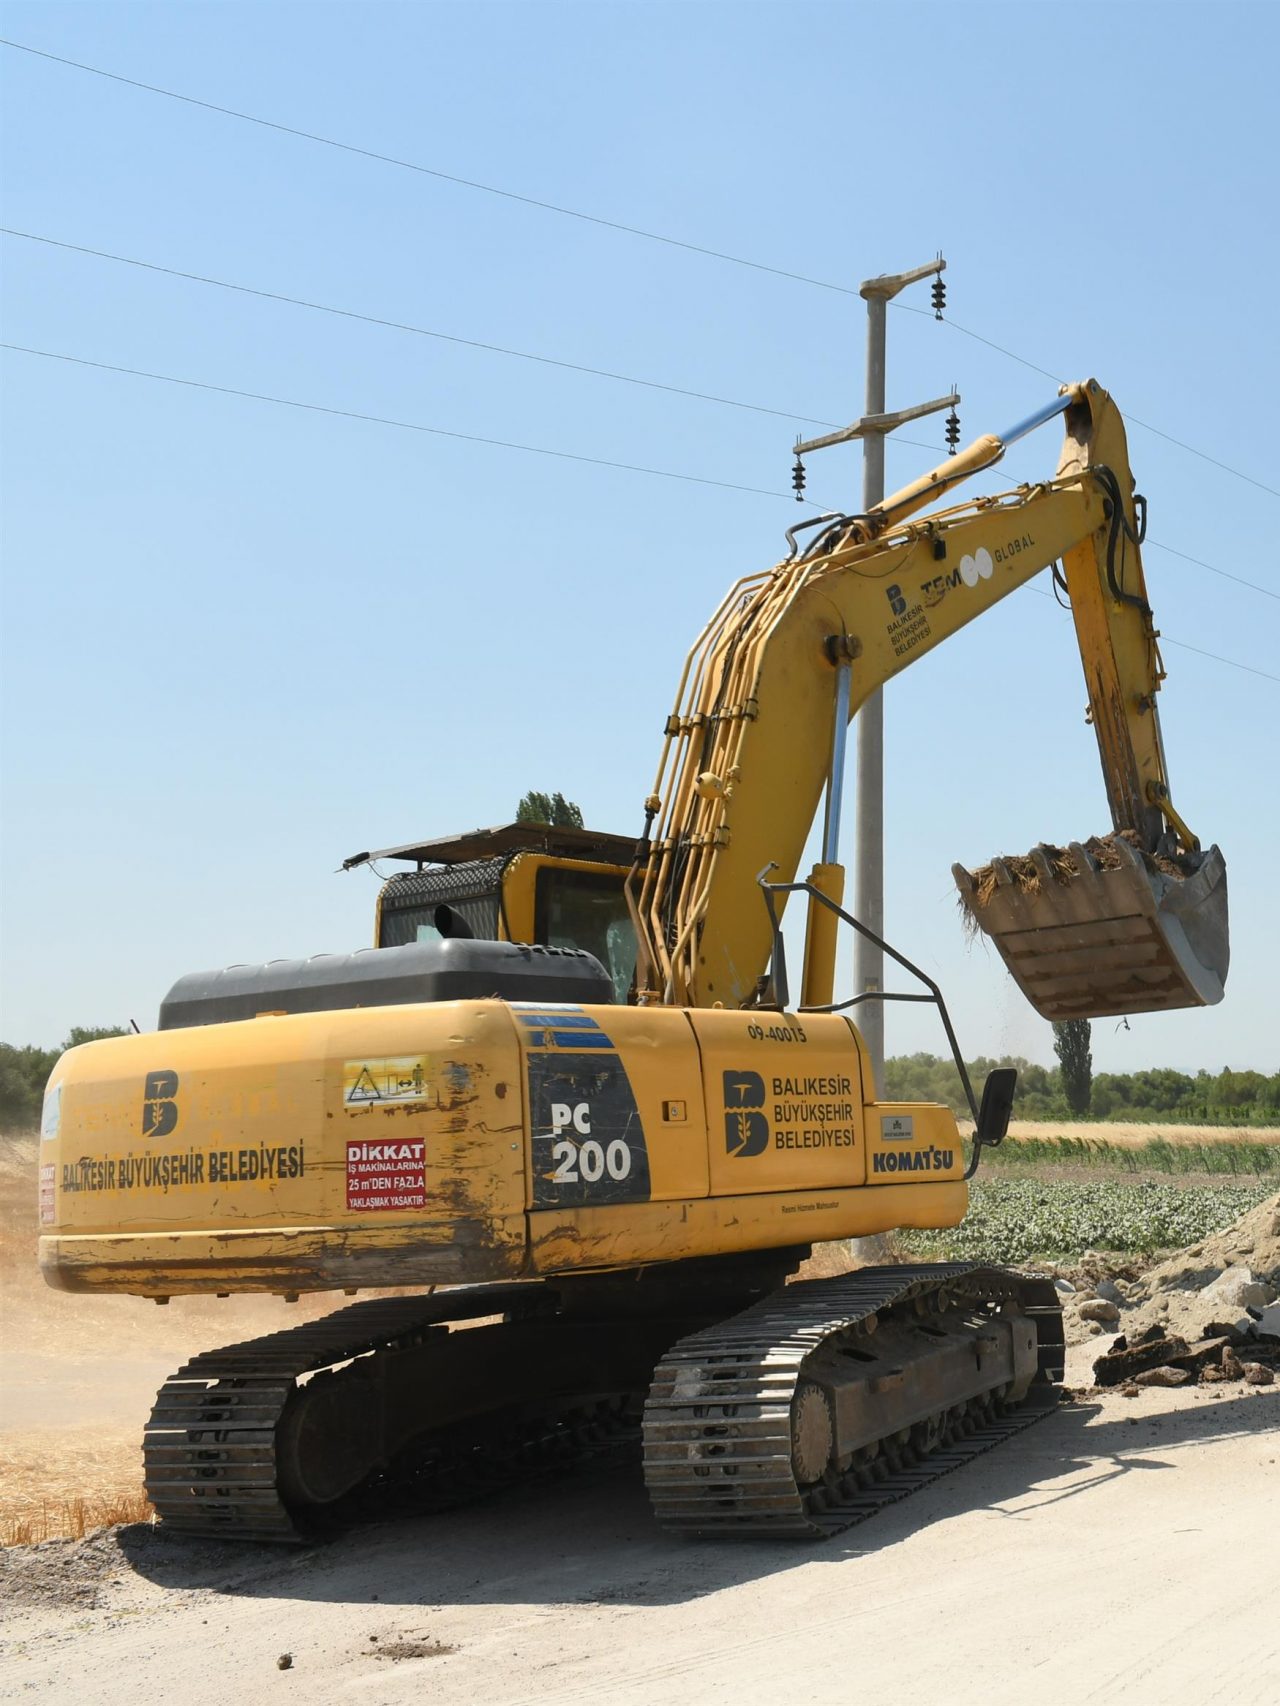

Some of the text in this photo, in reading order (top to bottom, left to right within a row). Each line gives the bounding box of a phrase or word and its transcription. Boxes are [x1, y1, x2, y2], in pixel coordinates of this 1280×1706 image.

[994, 533, 1035, 563] GLOBAL
[887, 604, 924, 634] BALIKESİR
[747, 1025, 807, 1043] 09-40015
[772, 1074, 852, 1096] BALIKESİR
[551, 1102, 591, 1135] PC
[774, 1099, 853, 1126] BÜYÜKŞEHİR
[775, 1124, 855, 1149] BELEDİYESİ
[118, 1147, 204, 1194] BÜYÜKŞEHİR
[208, 1138, 304, 1183] BELEDİYESİ
[348, 1143, 424, 1162] DİKKAT
[552, 1139, 631, 1183] 200
[873, 1145, 953, 1172] KOMATSU
[348, 1161, 424, 1174] İŞ MAKİNALARINA
[349, 1178, 359, 1191] 25
[394, 1176, 424, 1189] FAZLA
